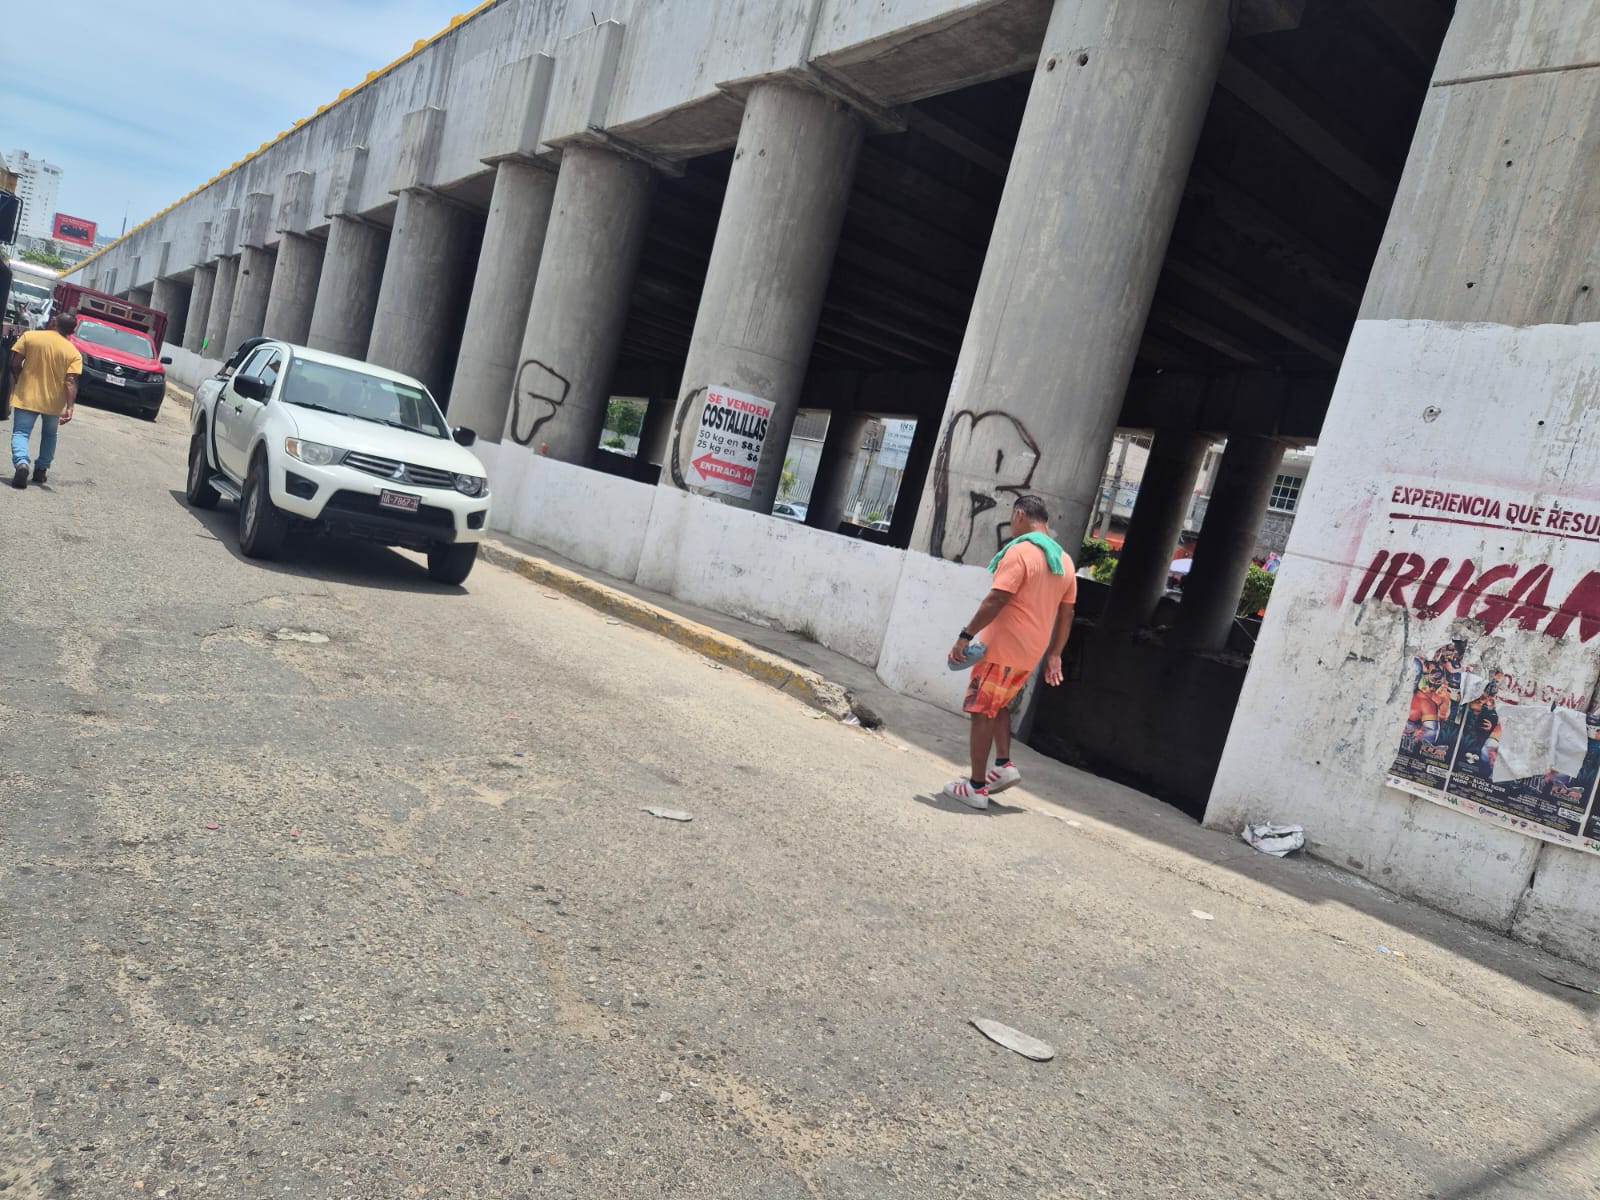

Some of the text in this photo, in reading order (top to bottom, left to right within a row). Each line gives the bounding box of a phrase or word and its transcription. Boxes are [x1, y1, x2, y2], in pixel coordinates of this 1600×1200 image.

[708, 393, 770, 417] SE VENDEN
[702, 403, 767, 441] COSTALILLAS
[697, 439, 758, 462] 25 kg en $6
[699, 429, 761, 453] 50 kg en $8.5
[700, 461, 741, 478] ENTRADA
[1391, 485, 1500, 519] EXPERIENCIA
[1505, 503, 1545, 526] QUE
